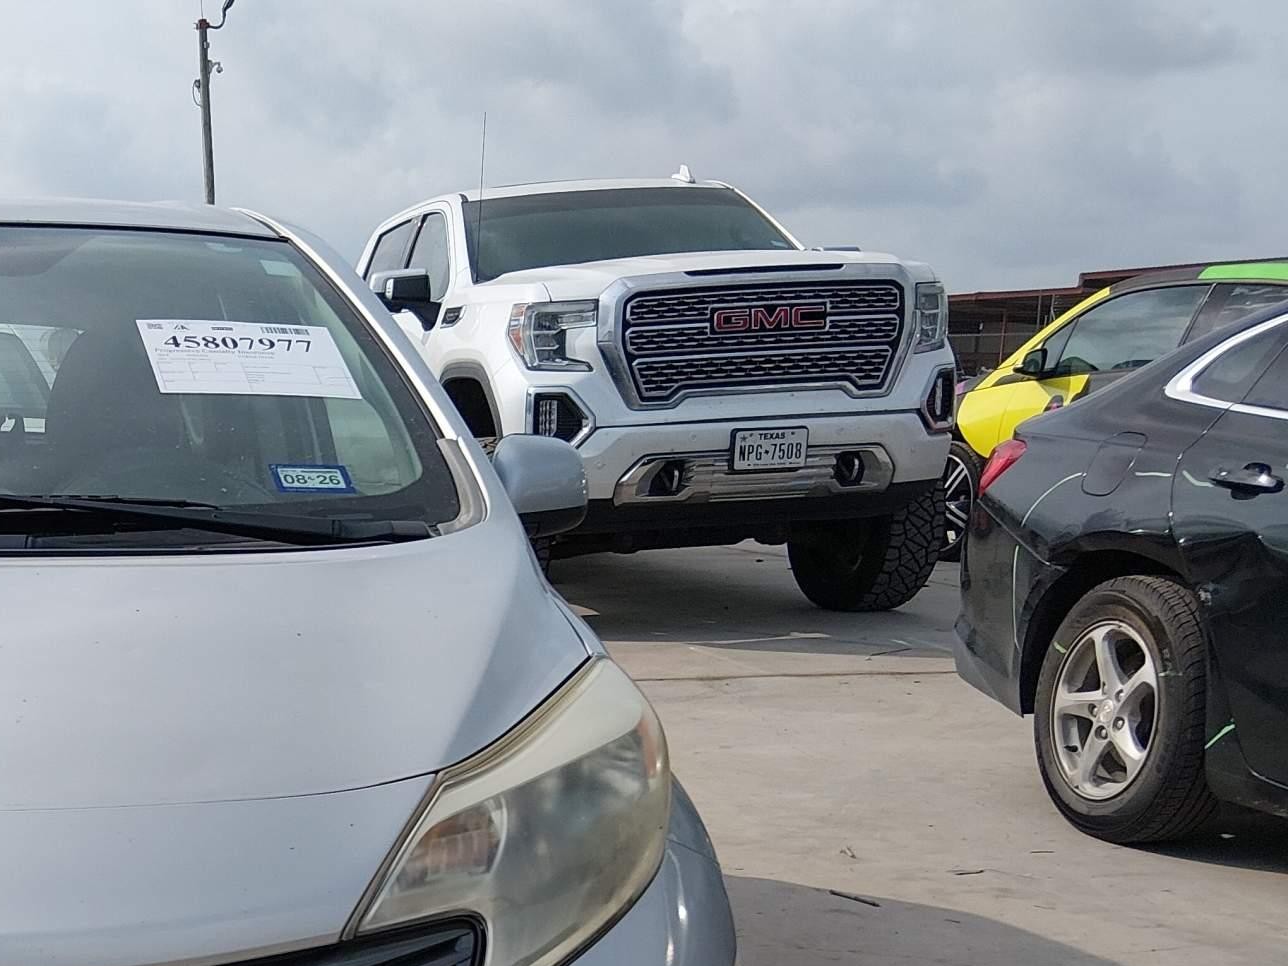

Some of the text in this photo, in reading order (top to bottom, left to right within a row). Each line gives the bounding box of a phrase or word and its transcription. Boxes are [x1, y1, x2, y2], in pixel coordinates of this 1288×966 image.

[714, 305, 825, 332] GMC
[164, 335, 312, 352] 45807977
[758, 432, 786, 440] TEXAS
